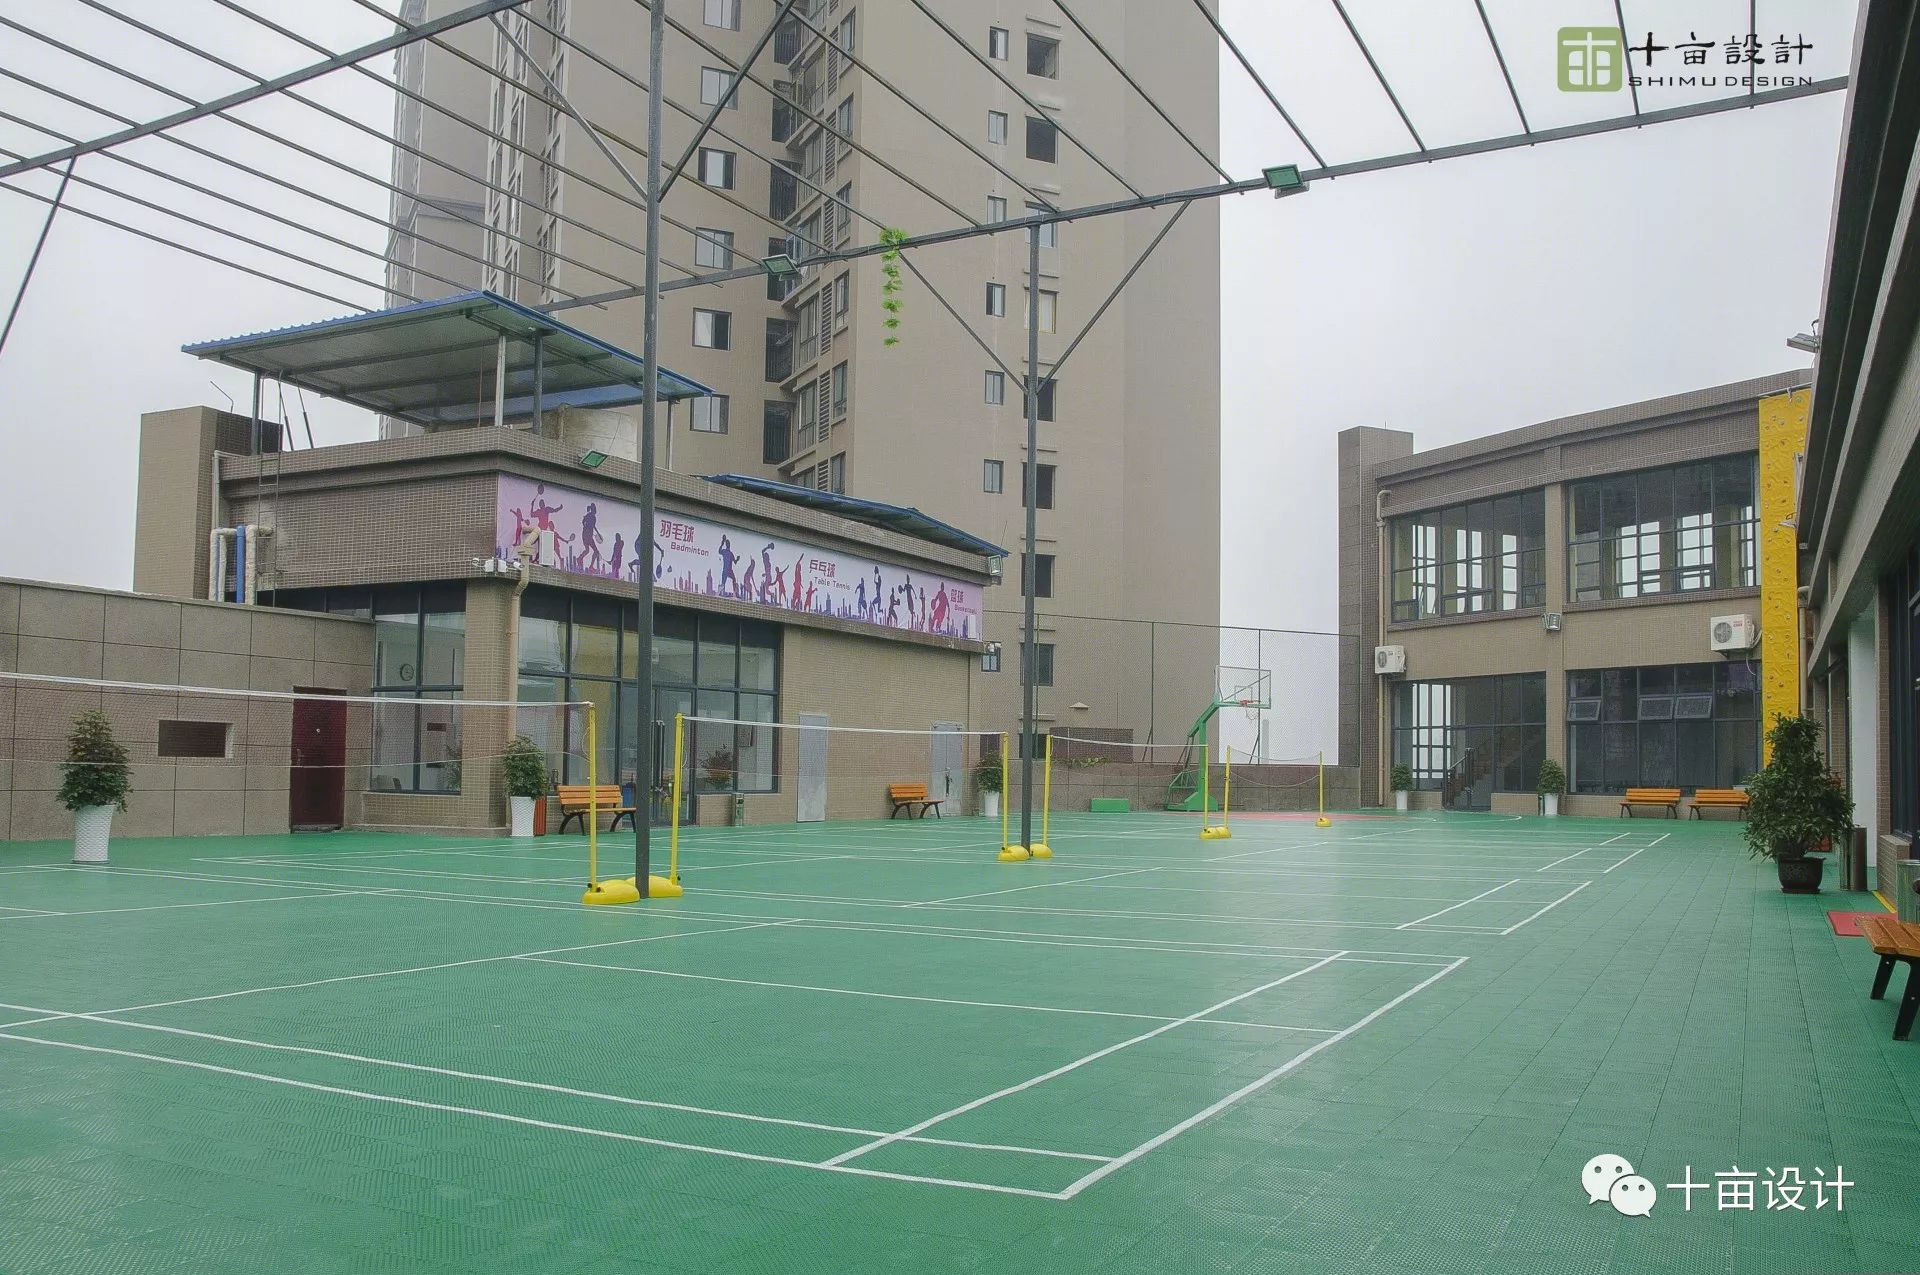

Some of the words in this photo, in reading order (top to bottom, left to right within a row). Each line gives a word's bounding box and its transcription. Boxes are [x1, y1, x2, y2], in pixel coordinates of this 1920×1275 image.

[660, 519, 695, 543] 羽毛球
[670, 541, 710, 557] Badminton
[809, 559, 836, 578] 乒乓球
[814, 576, 831, 587] Table
[832, 580, 851, 591] Tennis
